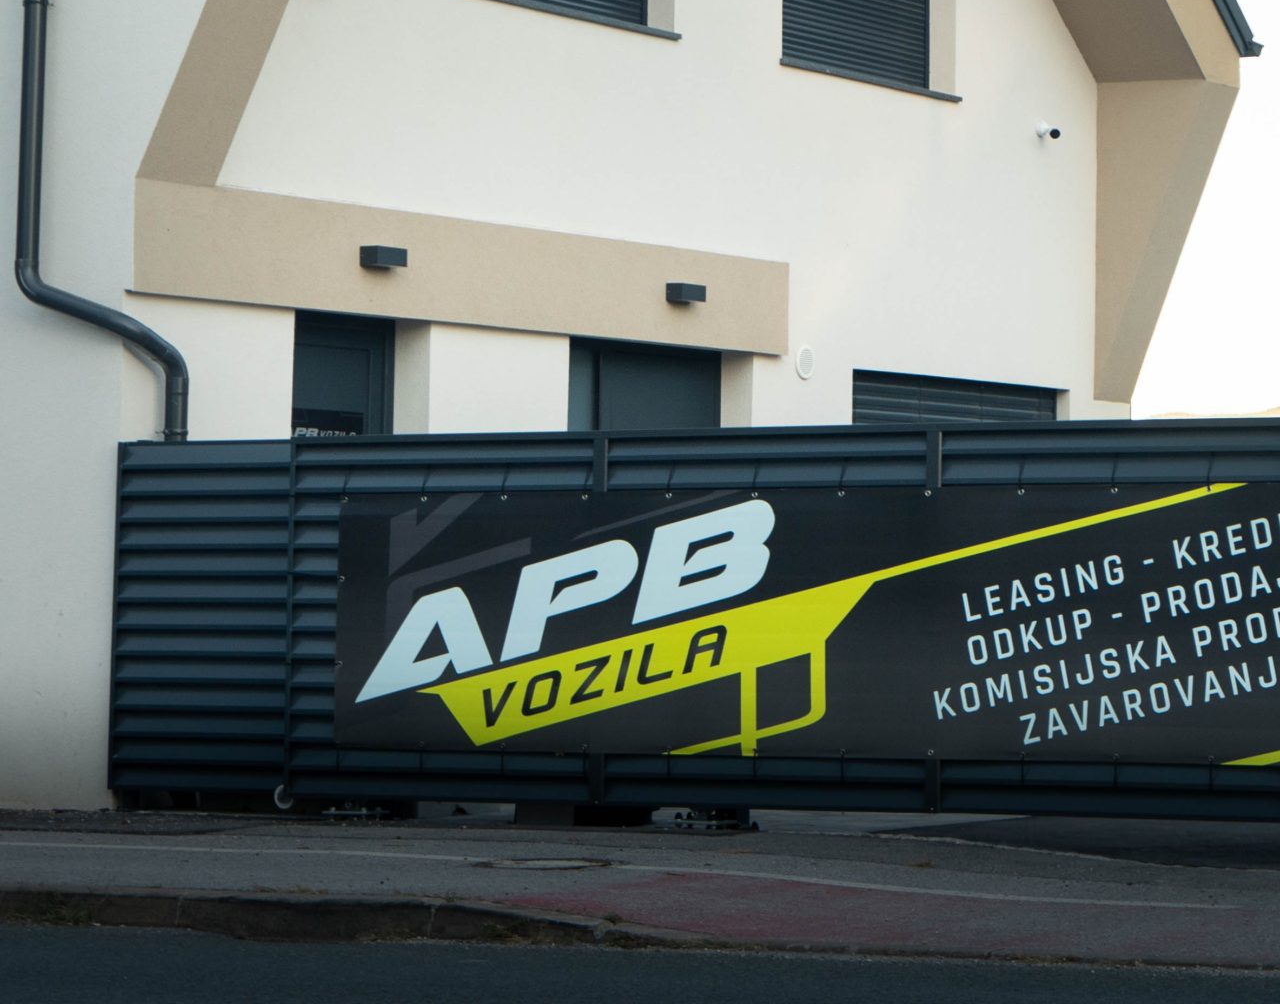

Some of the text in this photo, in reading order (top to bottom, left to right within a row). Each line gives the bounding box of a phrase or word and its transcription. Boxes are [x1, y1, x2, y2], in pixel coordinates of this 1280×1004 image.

[293, 426, 319, 437] PB
[354, 499, 776, 704] APB
[961, 554, 1125, 624] LEASING
[966, 608, 1092, 666] ODKUP
[482, 625, 727, 728] VOZILA
[932, 635, 1177, 721] KOMISIJSKA
